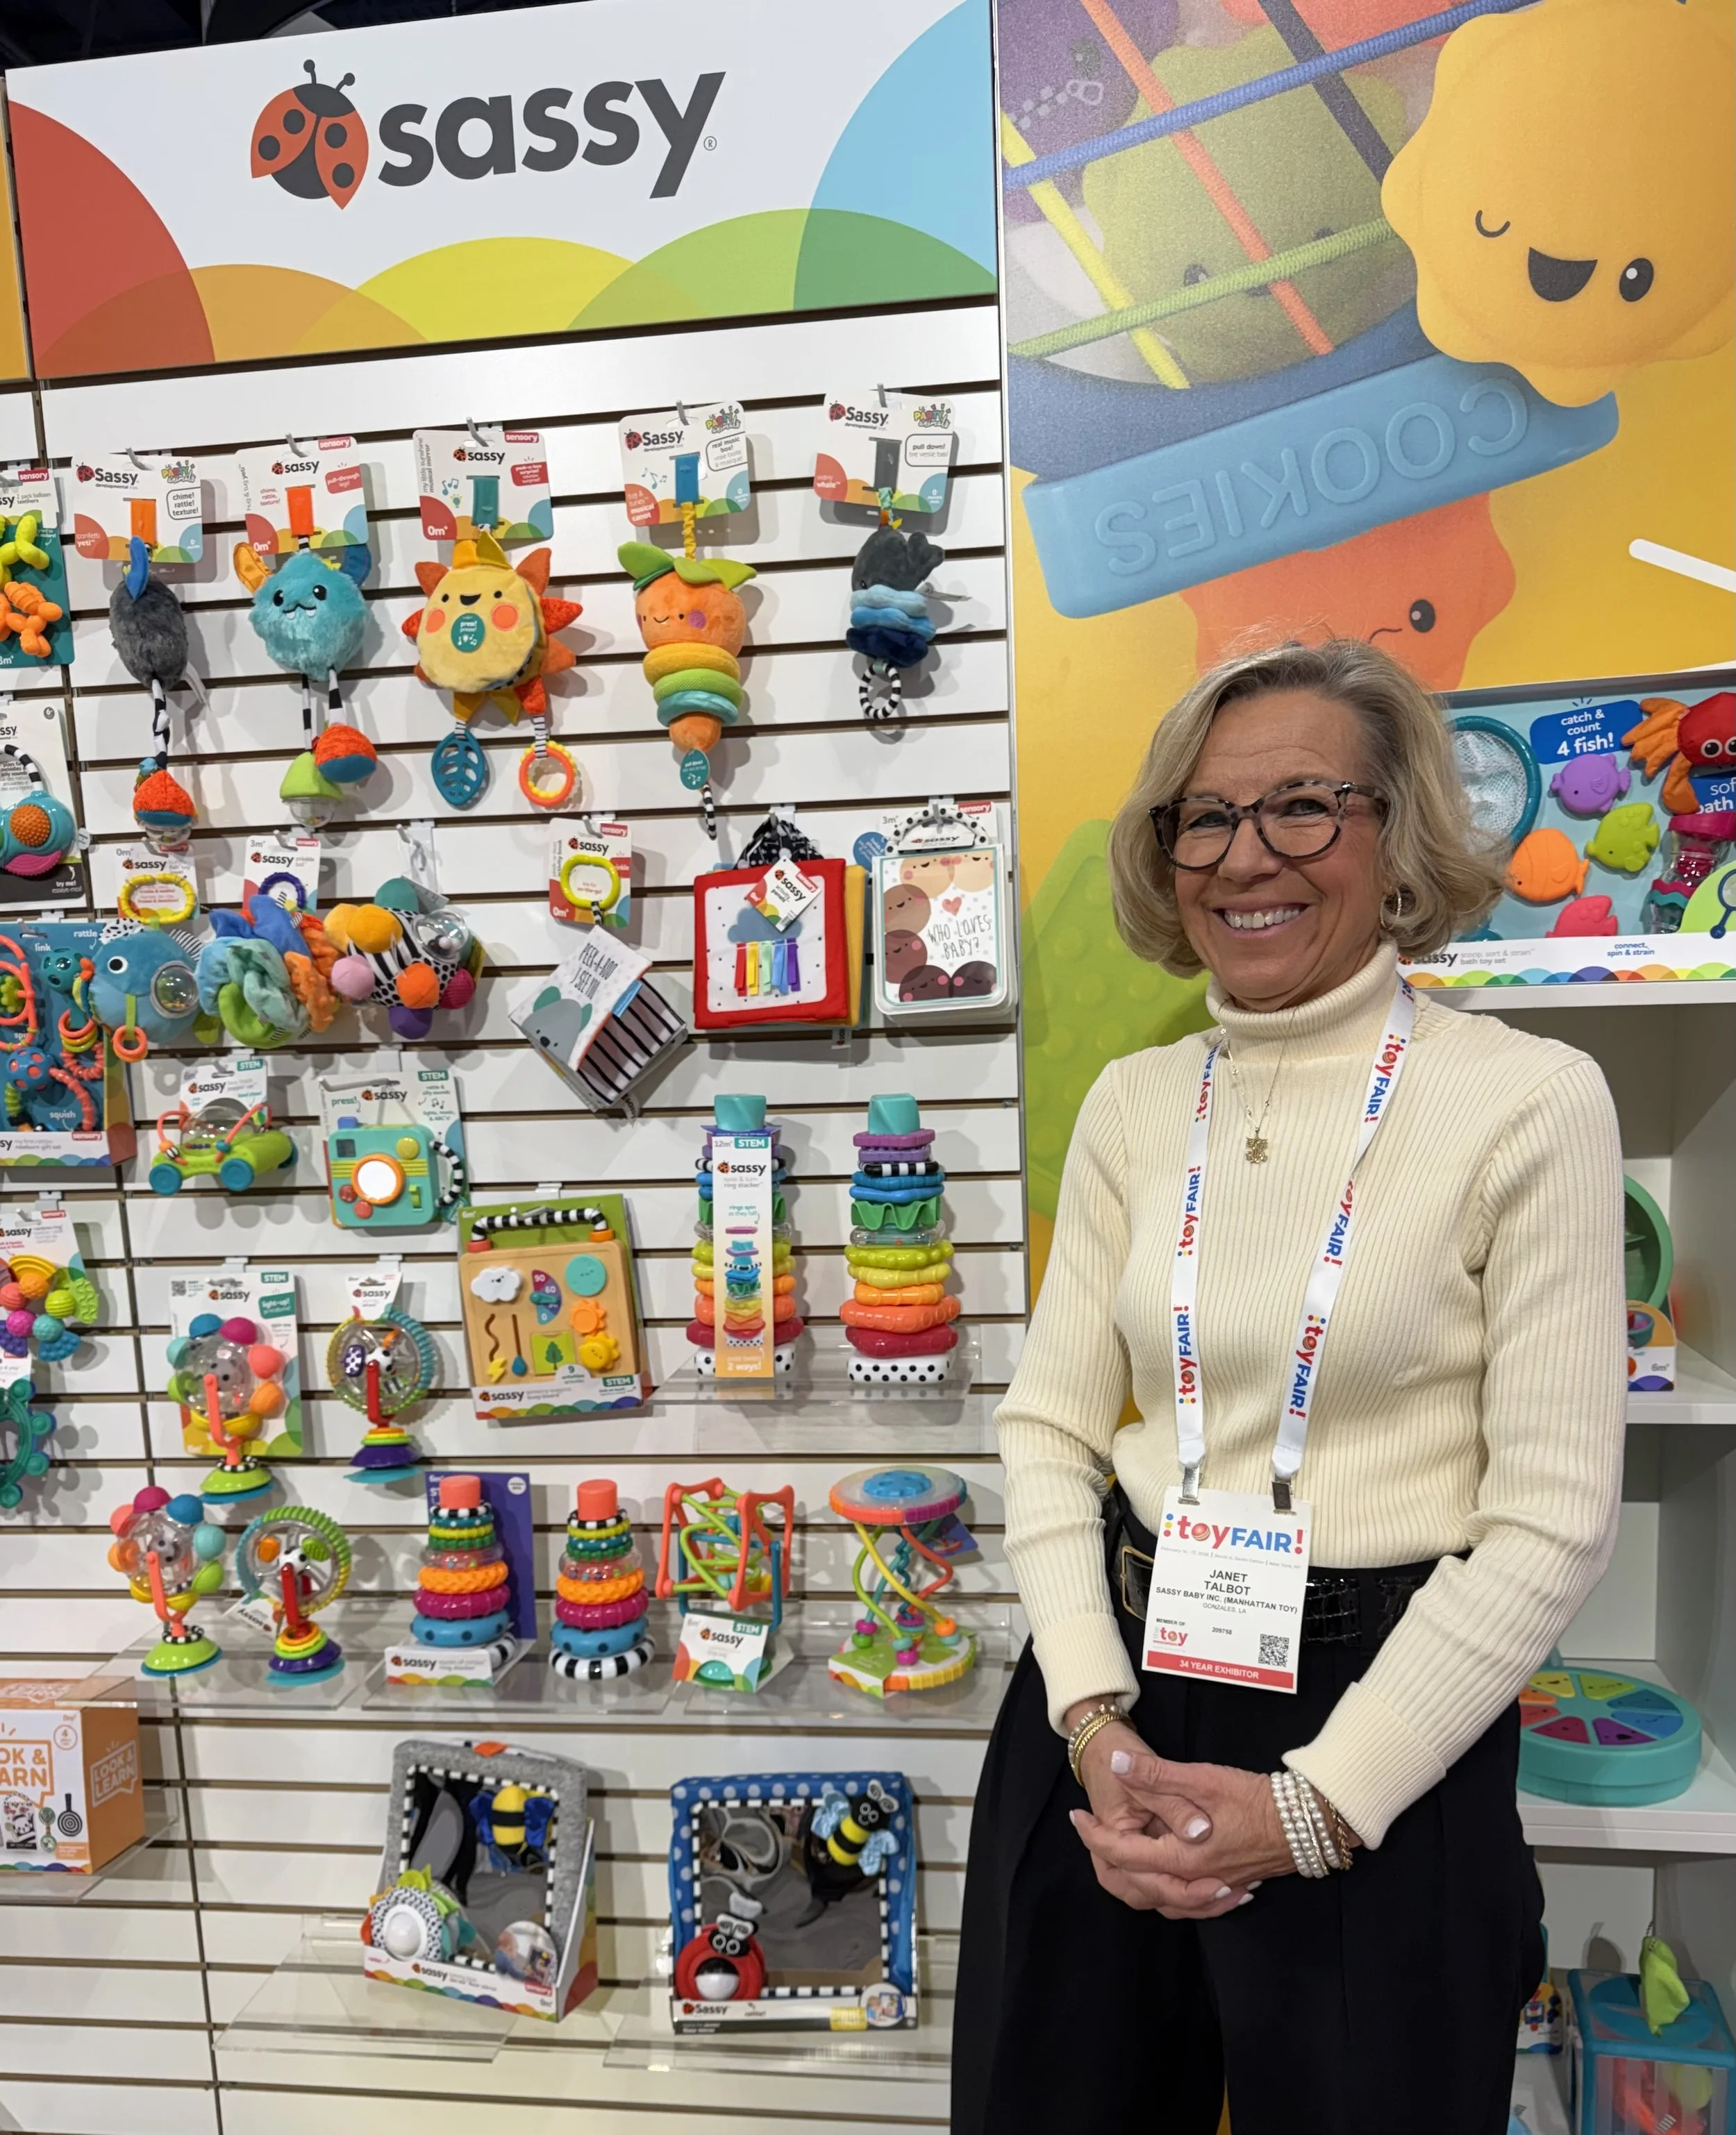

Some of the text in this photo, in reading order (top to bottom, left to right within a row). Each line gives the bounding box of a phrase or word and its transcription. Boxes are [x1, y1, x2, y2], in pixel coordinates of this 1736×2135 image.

[378, 72, 726, 199] sassy
[846, 407, 889, 426] Sassy
[319, 439, 350, 449] sensory
[506, 433, 537, 443] sensory
[642, 430, 684, 446] Sassy
[712, 437, 740, 449] real music
[467, 452, 506, 464] sassy
[285, 460, 320, 474] sassy
[19, 471, 48, 480] sensory
[94, 467, 138, 485] Sassy
[327, 473, 360, 485] pull-through
[426, 468, 435, 493] musical
[1094, 377, 1529, 576] COOKIES
[172, 492, 194, 501] chime!
[172, 508, 199, 517] texture!
[1560, 708, 1605, 726] catch &
[1567, 721, 1601, 736] count
[1556, 732, 1614, 756] 4 fish!
[959, 803, 992, 814] sensory
[579, 841, 610, 856] sassy
[135, 861, 167, 871] sassy
[262, 855, 294, 868] sassy
[781, 878, 807, 902] sassy
[74, 929, 98, 938] rattle
[927, 913, 992, 944] WHO LOVES
[35, 943, 51, 951] link
[942, 936, 980, 961] BABY?
[1614, 941, 1649, 951] connect,
[1606, 948, 1623, 957] spin
[578, 942, 619, 980] PEEK-A-BOO
[574, 971, 592, 993] SEE
[240, 1060, 260, 1070] STEM
[198, 1082, 226, 1094] sassy
[331, 1096, 358, 1107] press!
[374, 1091, 408, 1103] sassy
[49, 1110, 76, 1120] squish
[738, 1139, 765, 1148] STEM
[731, 1164, 767, 1177] sassy
[6, 1228, 32, 1238] sassy
[263, 1274, 286, 1282] STEM
[534, 1274, 546, 1282] 90
[362, 1290, 391, 1300] sassy
[544, 1285, 556, 1293] 60
[219, 1291, 251, 1303] sassy
[734, 1362, 762, 1373] ways!
[606, 1377, 631, 1387] STEM
[491, 1391, 524, 1402] sassy
[1209, 1568, 1248, 1583] JANET
[1203, 1580, 1251, 1596] TALBOT
[1155, 1586, 1298, 1614] SASSY BABY INC. (MANHATTAN TOY)
[1156, 1617, 1178, 1626] MEMBER
[737, 1623, 760, 1634] STEM
[1212, 1626, 1233, 1635] 209758
[711, 1632, 744, 1649] sassy
[1160, 1626, 1189, 1647] toy
[403, 1658, 437, 1672] sassy
[1179, 1659, 1260, 1680] 34 YEAR EXHIBITOR
[32, 1748, 47, 1766] &
[94, 1750, 134, 1782] LOOK &
[96, 1764, 136, 1799] LEARN
[421, 1967, 448, 1983] sassy
[694, 2004, 728, 2016] Sassy
